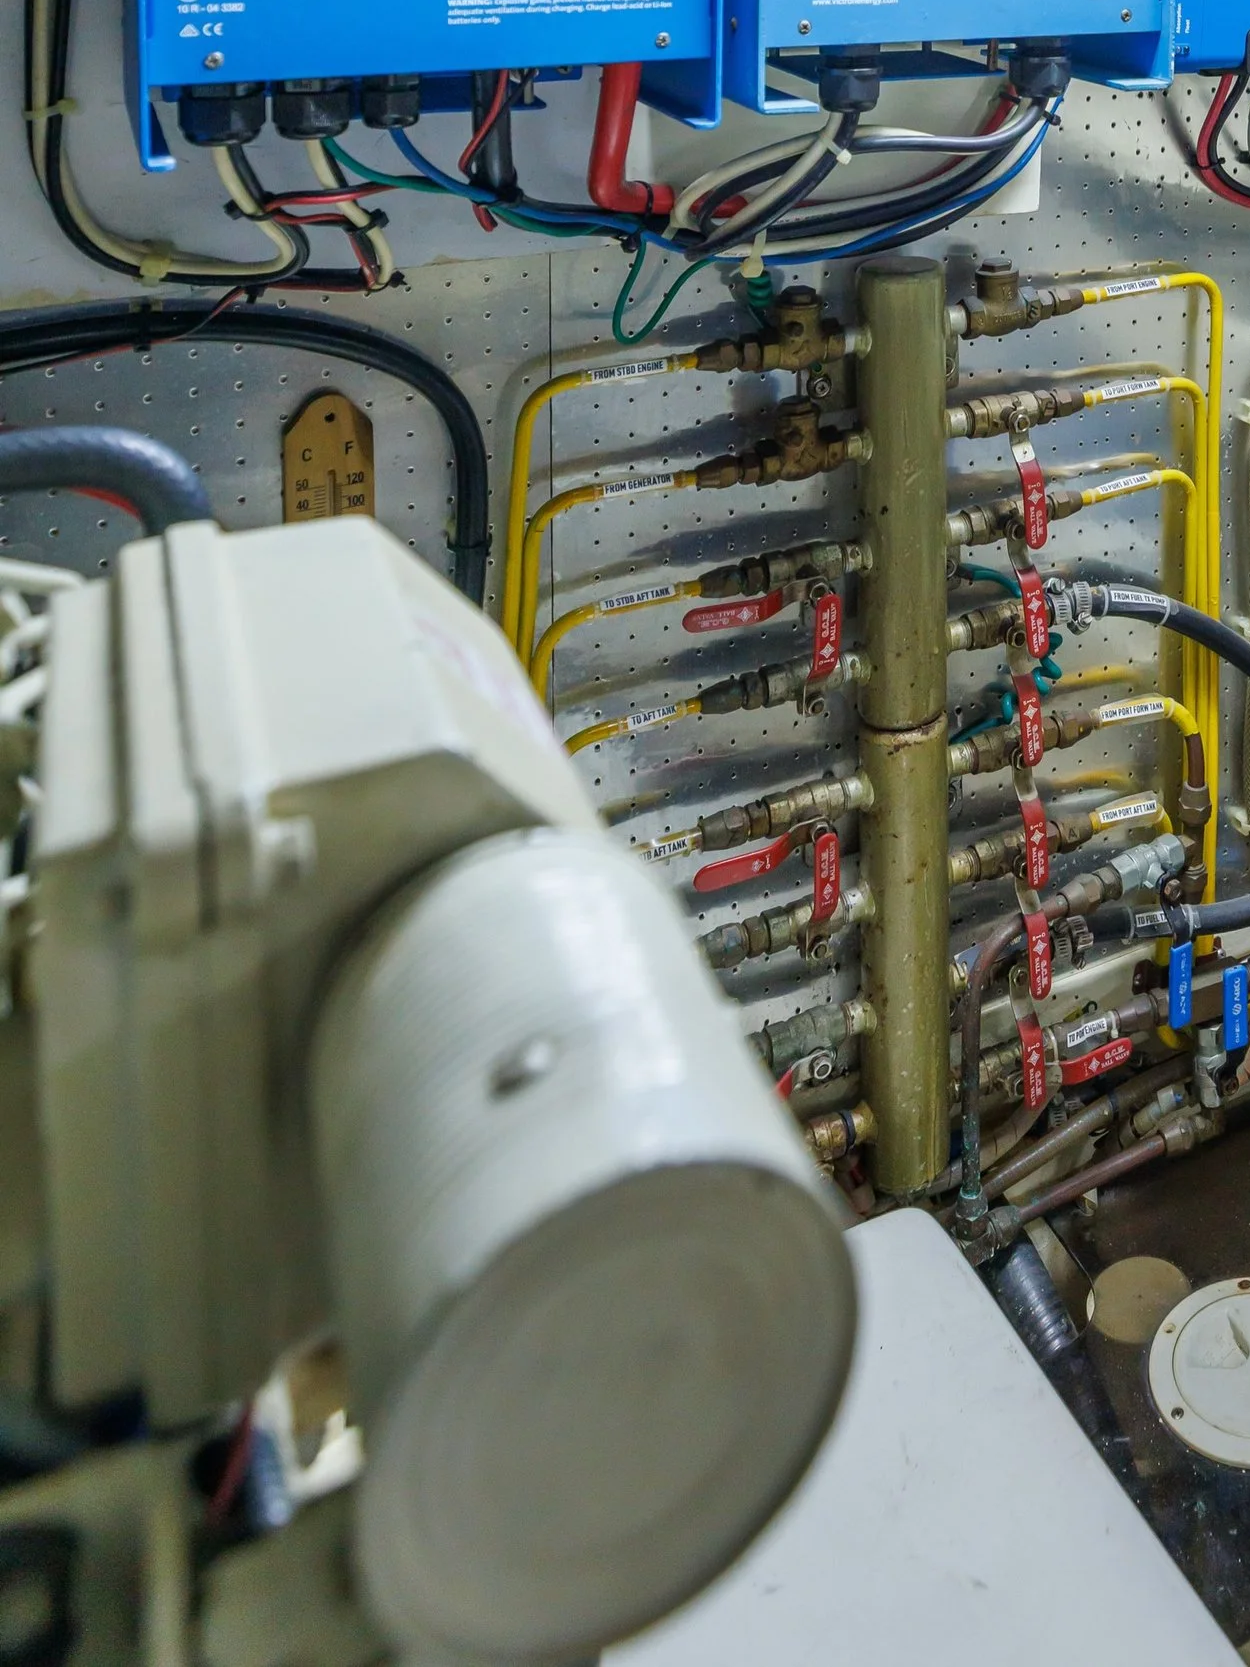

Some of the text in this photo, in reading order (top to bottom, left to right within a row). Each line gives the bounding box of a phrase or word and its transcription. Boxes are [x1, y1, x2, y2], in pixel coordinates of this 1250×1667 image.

[1123, 283, 1137, 291] PORT
[1138, 279, 1157, 289] ENGINE
[594, 360, 664, 380] FROM STBD ENGINE
[301, 448, 312, 462] C
[345, 440, 354, 455] F
[296, 478, 309, 491] 50
[346, 471, 364, 485] 120
[605, 473, 671, 494] FROM GENERATOR
[296, 499, 309, 510] 40
[347, 494, 365, 506] 100
[605, 587, 670, 608] TO STDB AFT TANK
[632, 705, 676, 725] TO AFT TANK
[1102, 701, 1163, 719] FROM PORT FORW TANK
[1102, 802, 1156, 820] FROM PORT AFT TANK
[653, 838, 688, 858] AFT TANK
[1068, 1020, 1106, 1043] TO ENGINE
